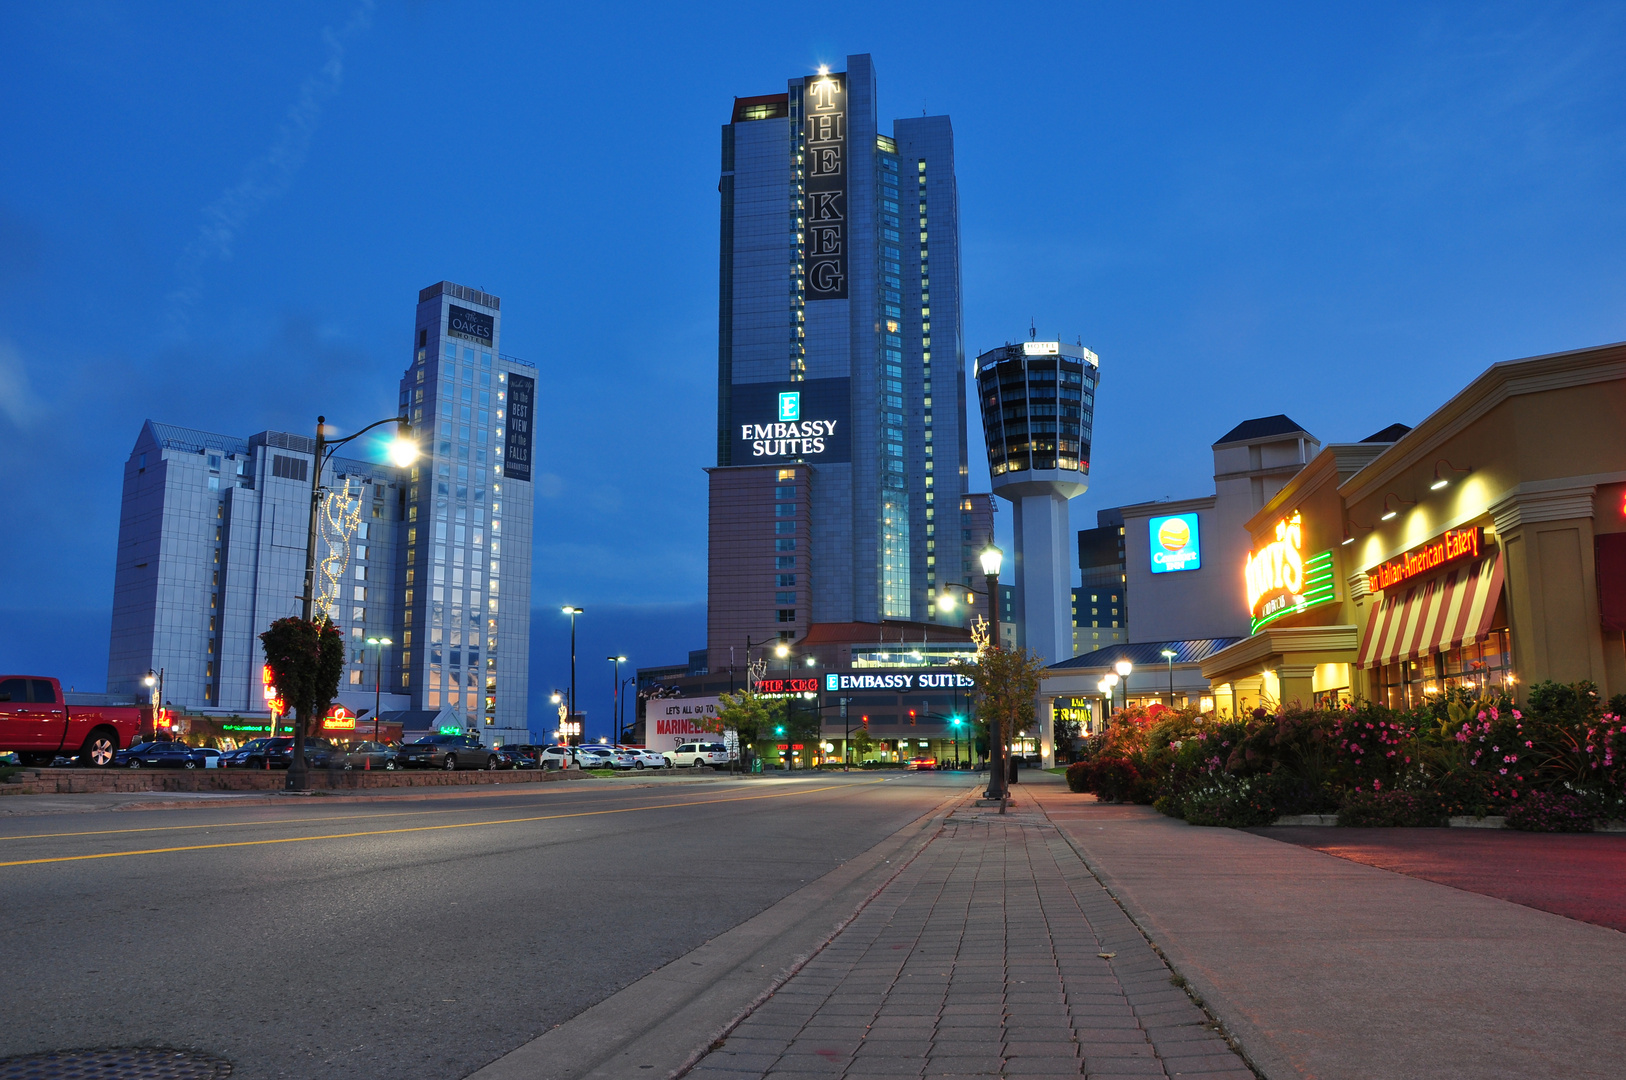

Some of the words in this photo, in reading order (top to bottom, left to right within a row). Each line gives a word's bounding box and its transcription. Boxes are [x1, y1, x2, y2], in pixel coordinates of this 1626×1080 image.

[807, 79, 844, 177] THE
[808, 191, 845, 292] KEG
[452, 318, 490, 338] OAKES
[457, 332, 485, 344] HOTEL
[512, 403, 528, 418] BEST
[511, 417, 528, 433] VIEW
[741, 420, 838, 441] EMBASSY
[509, 446, 528, 462] FALLS
[752, 437, 826, 457] SUITES
[1444, 526, 1479, 561] Eatery
[754, 679, 784, 693] THE
[785, 678, 819, 692] KEG
[840, 674, 914, 689] EMBASSY
[918, 673, 975, 688] SUITES
[665, 705, 680, 715] LET'S
[682, 704, 693, 714] ALL
[694, 704, 704, 714] GO
[705, 704, 714, 714] TO
[656, 716, 724, 735] MARINELD
